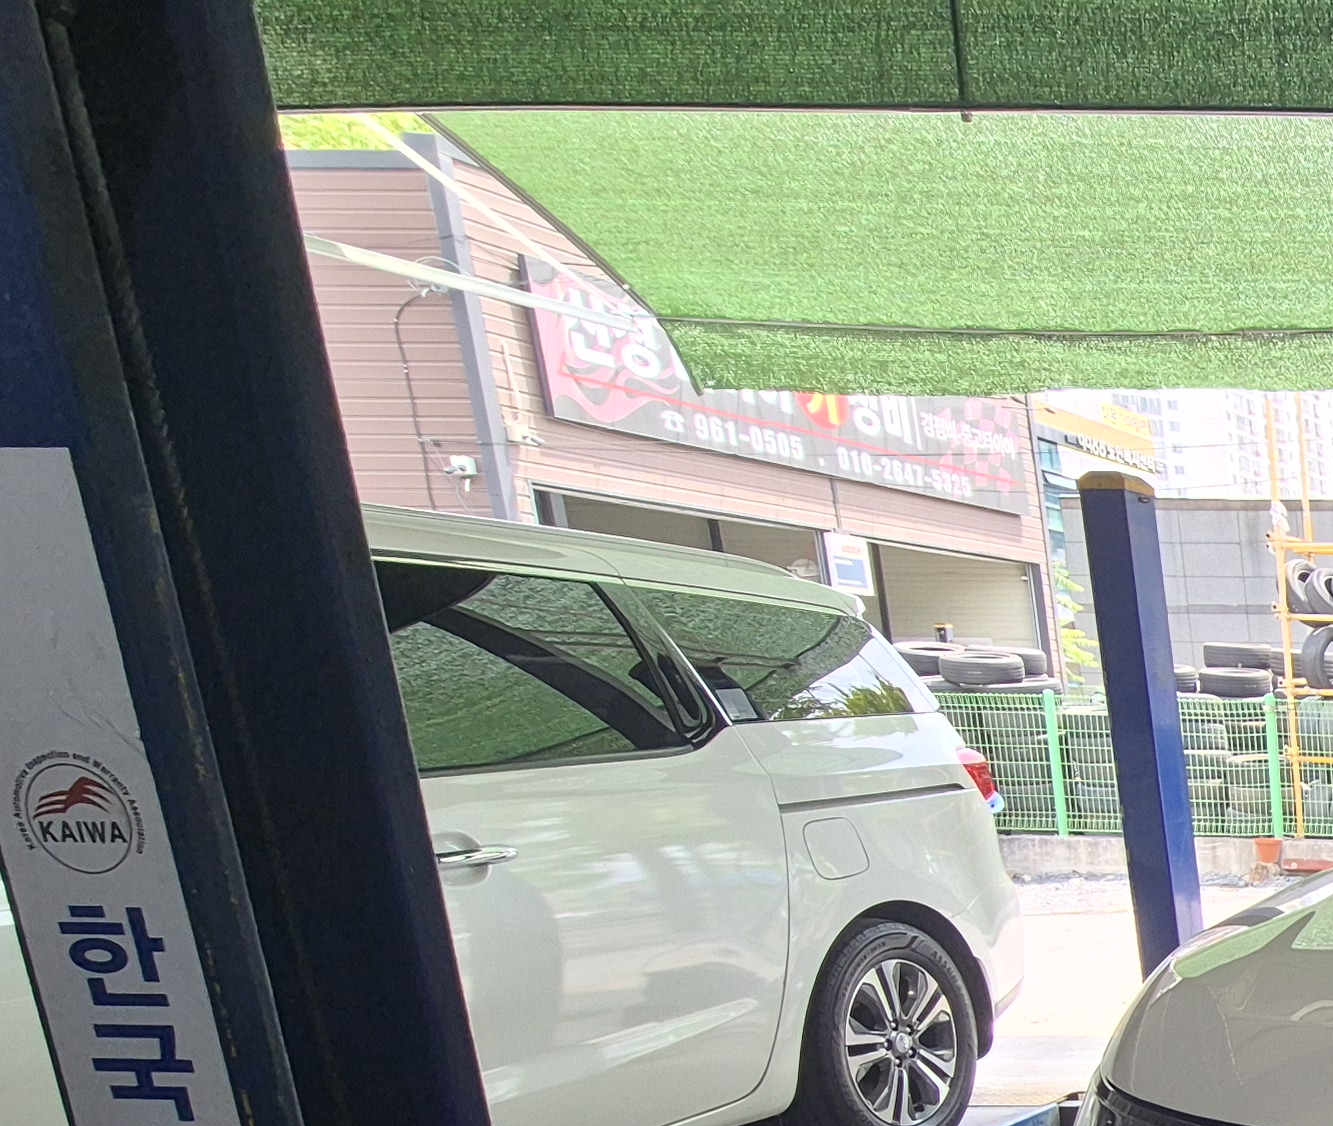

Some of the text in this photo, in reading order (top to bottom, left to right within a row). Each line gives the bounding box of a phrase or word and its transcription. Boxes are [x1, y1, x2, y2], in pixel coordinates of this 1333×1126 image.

[693, 413, 804, 460] 961-0505
[836, 446, 973, 497] 010-2647-5325
[37, 820, 129, 845] KAIWA
